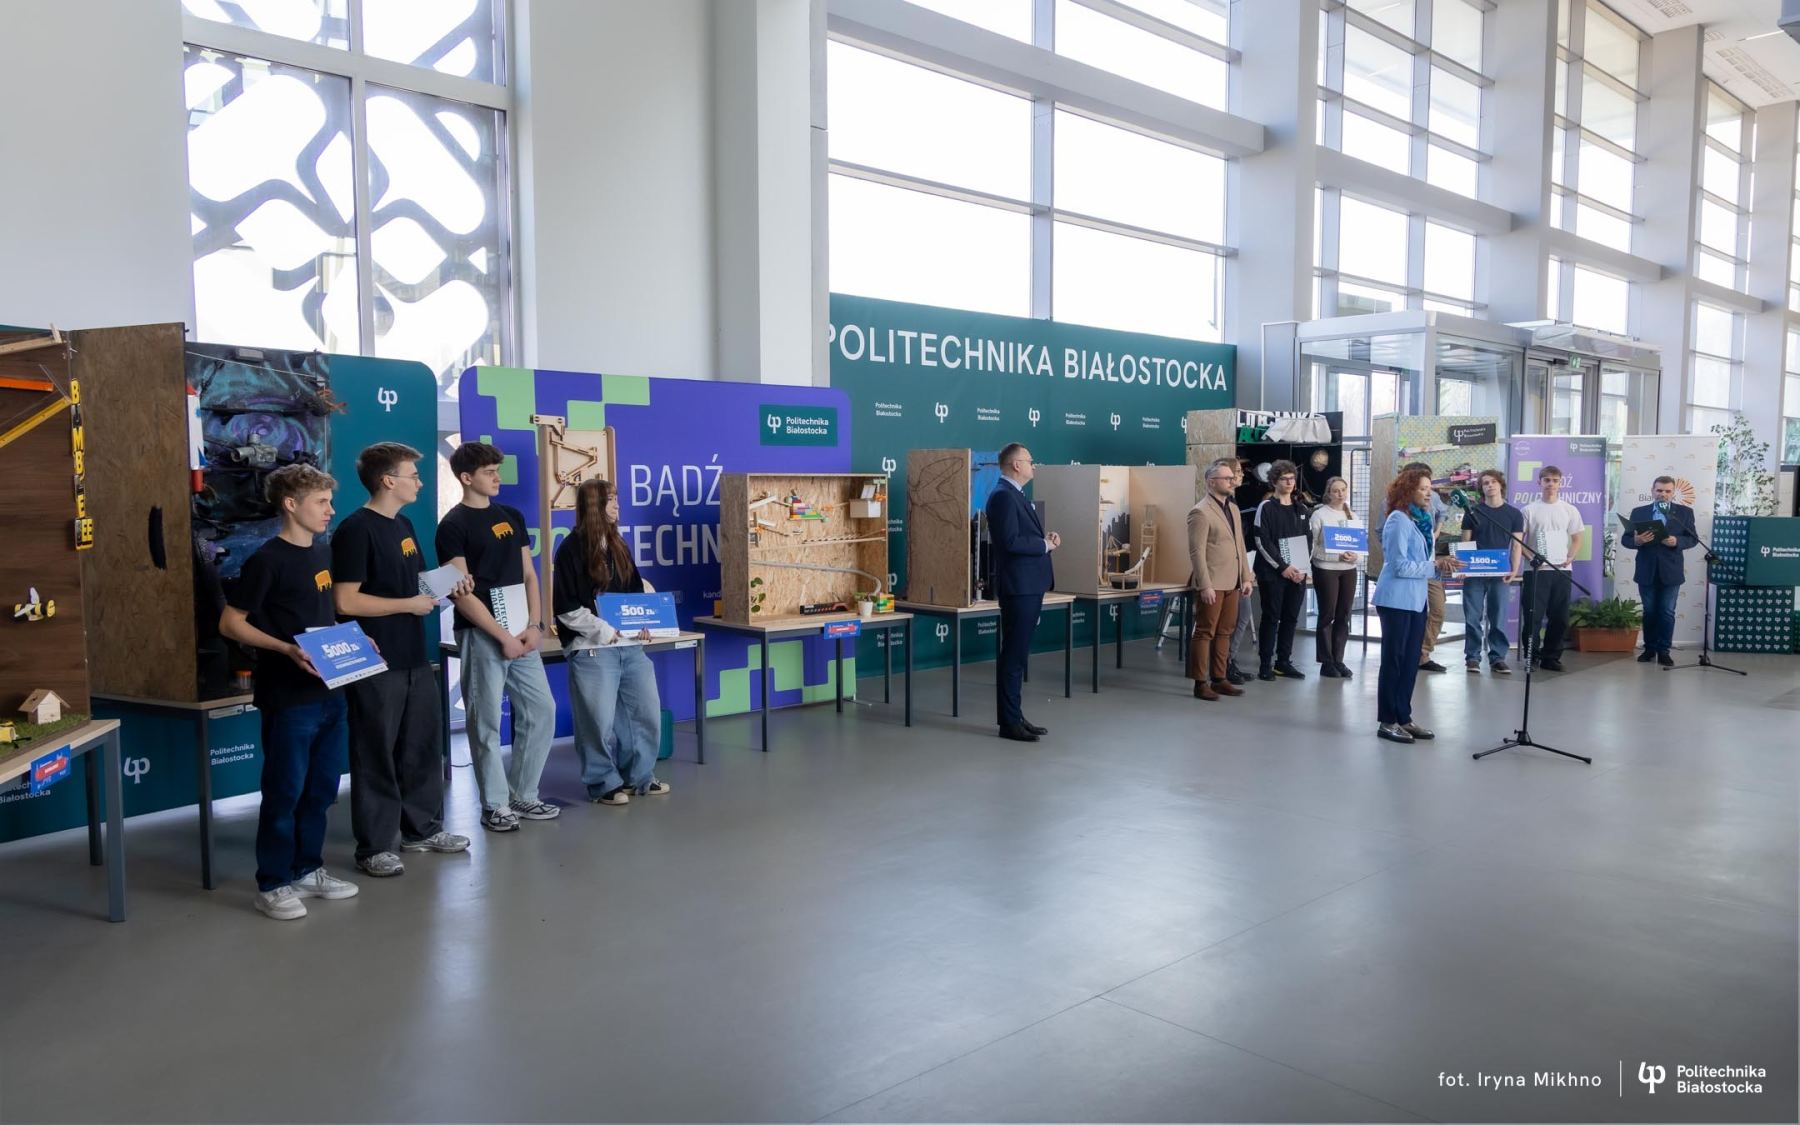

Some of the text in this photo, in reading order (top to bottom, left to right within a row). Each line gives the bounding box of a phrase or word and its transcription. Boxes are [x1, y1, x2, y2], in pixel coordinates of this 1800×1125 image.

[1064, 348, 1227, 391] BIAŁOSTOCKA
[786, 416, 829, 426] Politechnika
[786, 426, 828, 435] Białostocka
[630, 453, 723, 517] BĄDŹ
[1470, 556, 1490, 564] 1500
[621, 604, 645, 616] 500
[321, 641, 352, 658] 5000
[210, 743, 255, 756] Politechnika
[211, 753, 254, 766] Białostocka
